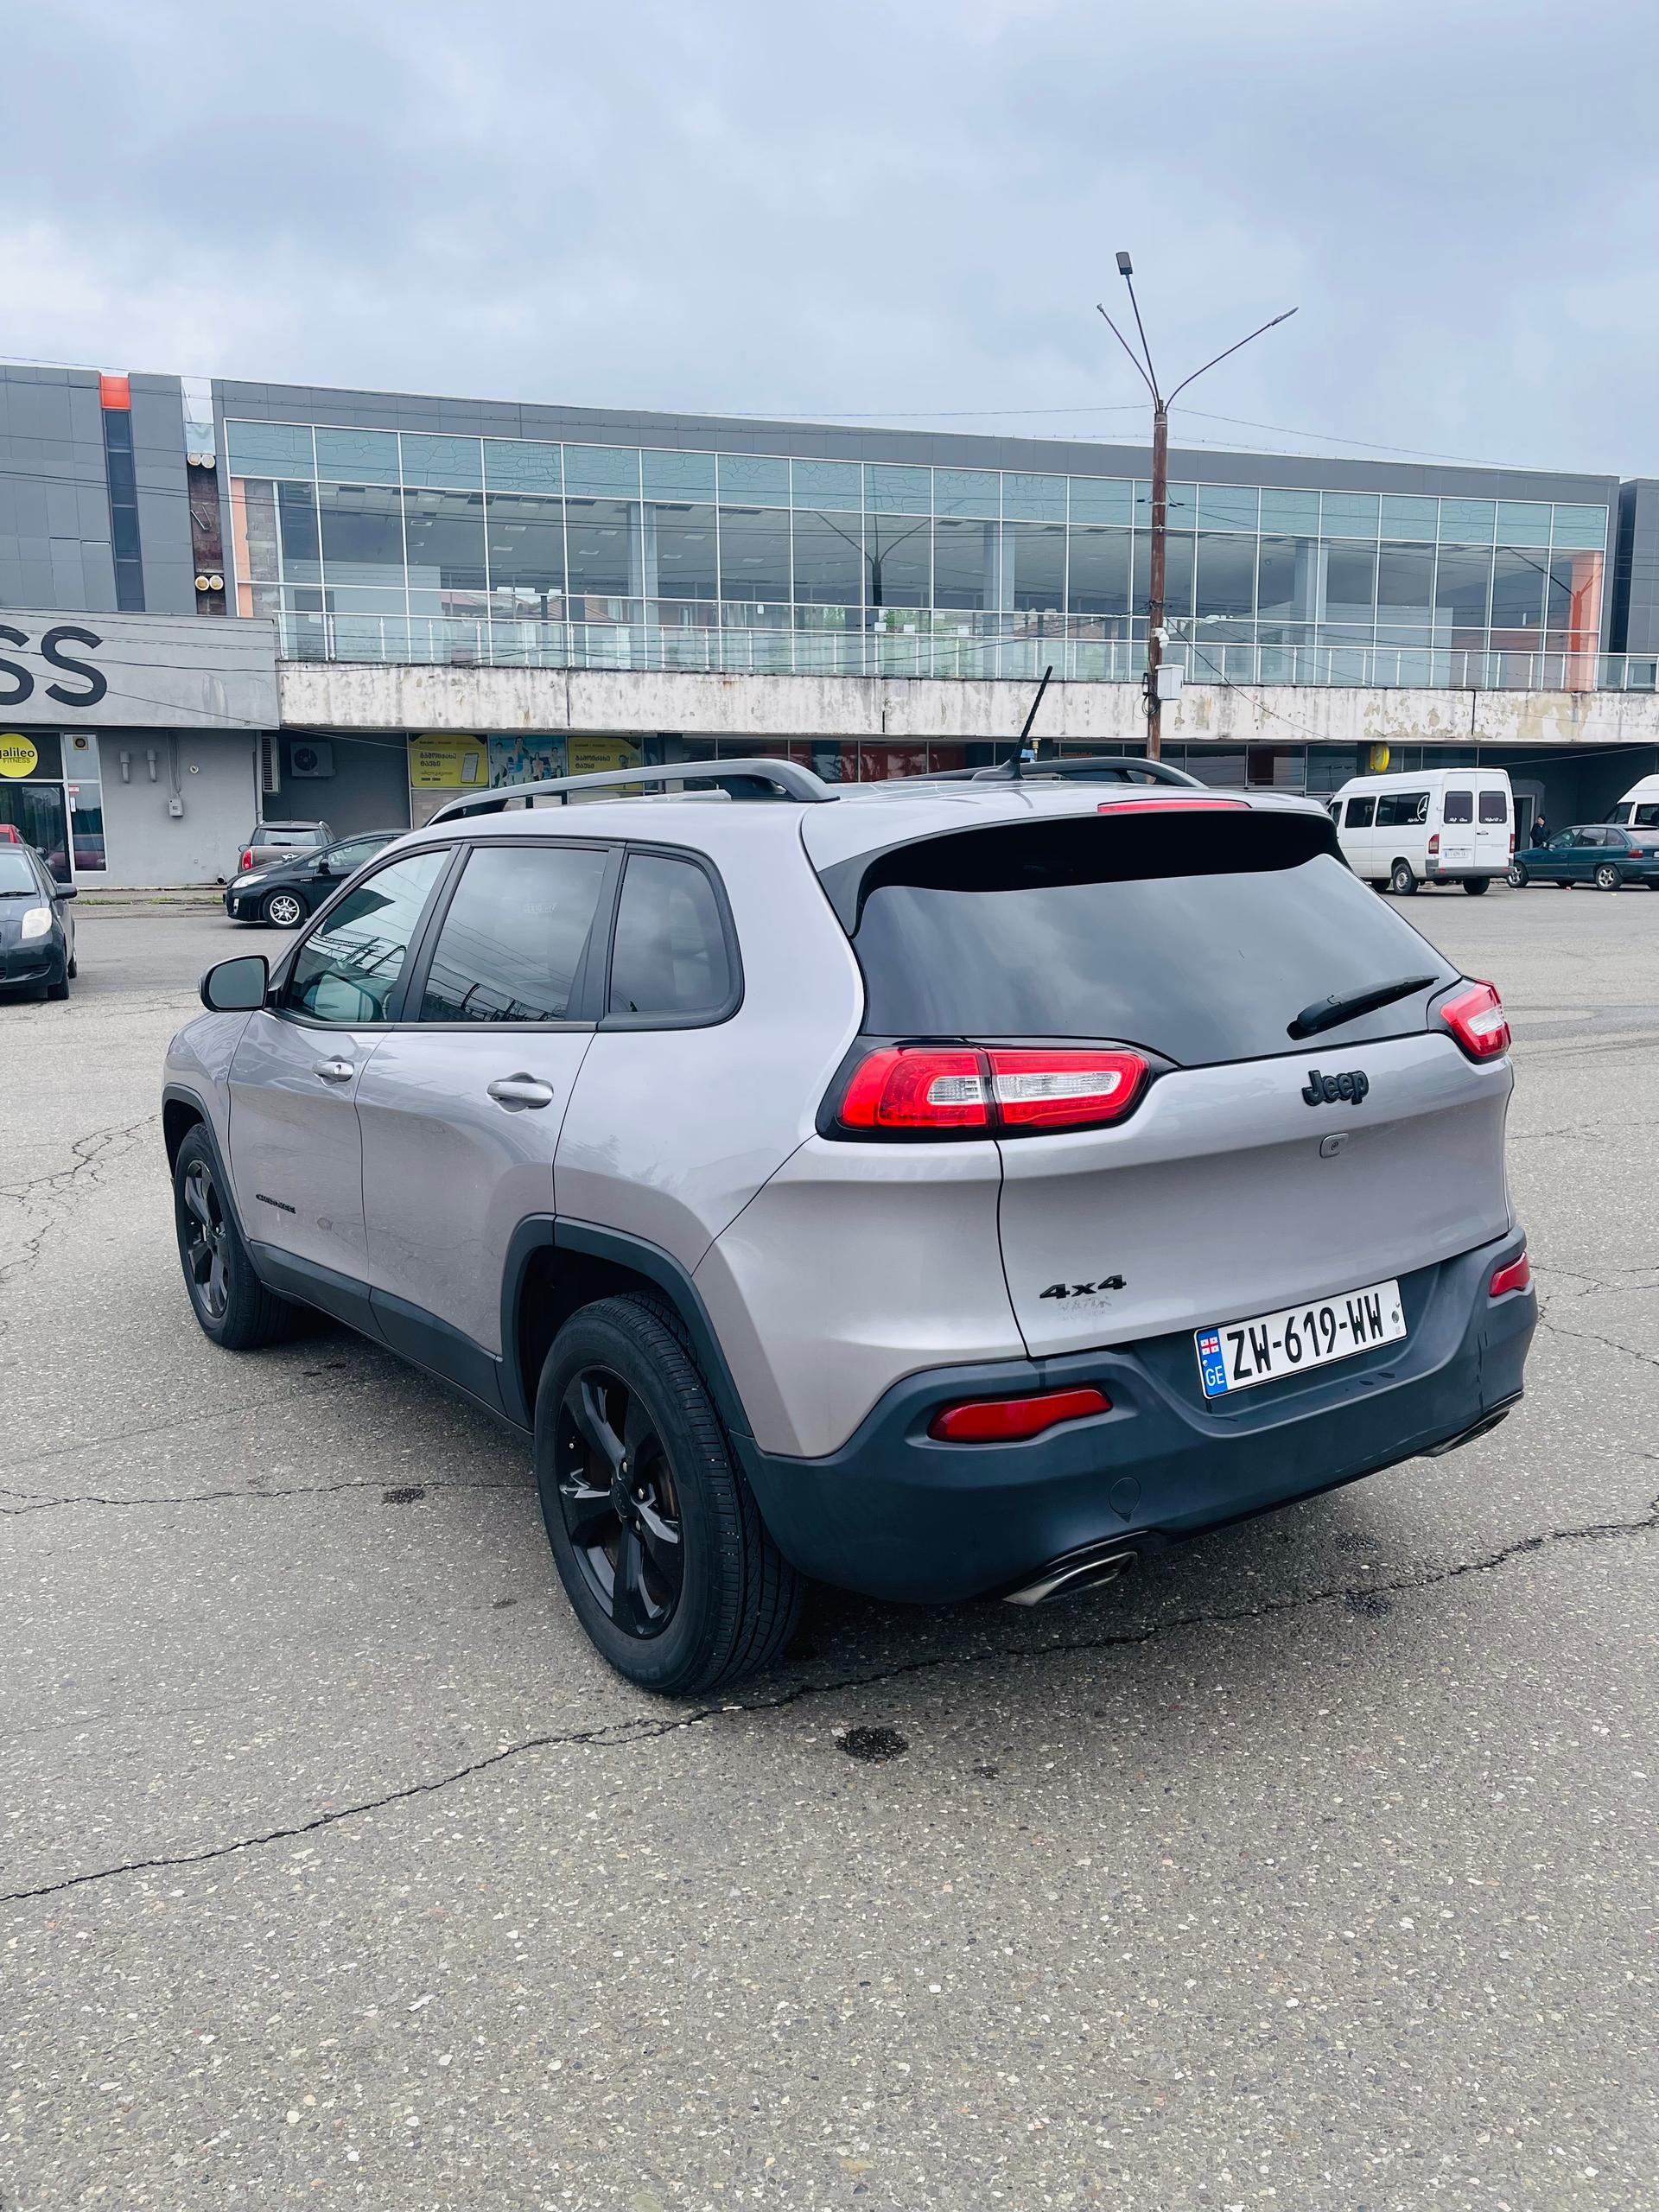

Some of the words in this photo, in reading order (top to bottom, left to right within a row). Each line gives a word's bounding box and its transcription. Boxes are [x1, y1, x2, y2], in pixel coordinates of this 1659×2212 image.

[0, 747, 35, 759] alileo
[1301, 1070, 1369, 1107] Jeep
[1226, 1293, 1384, 1381] ZW-619-WW
[1205, 1365, 1225, 1387] GE
